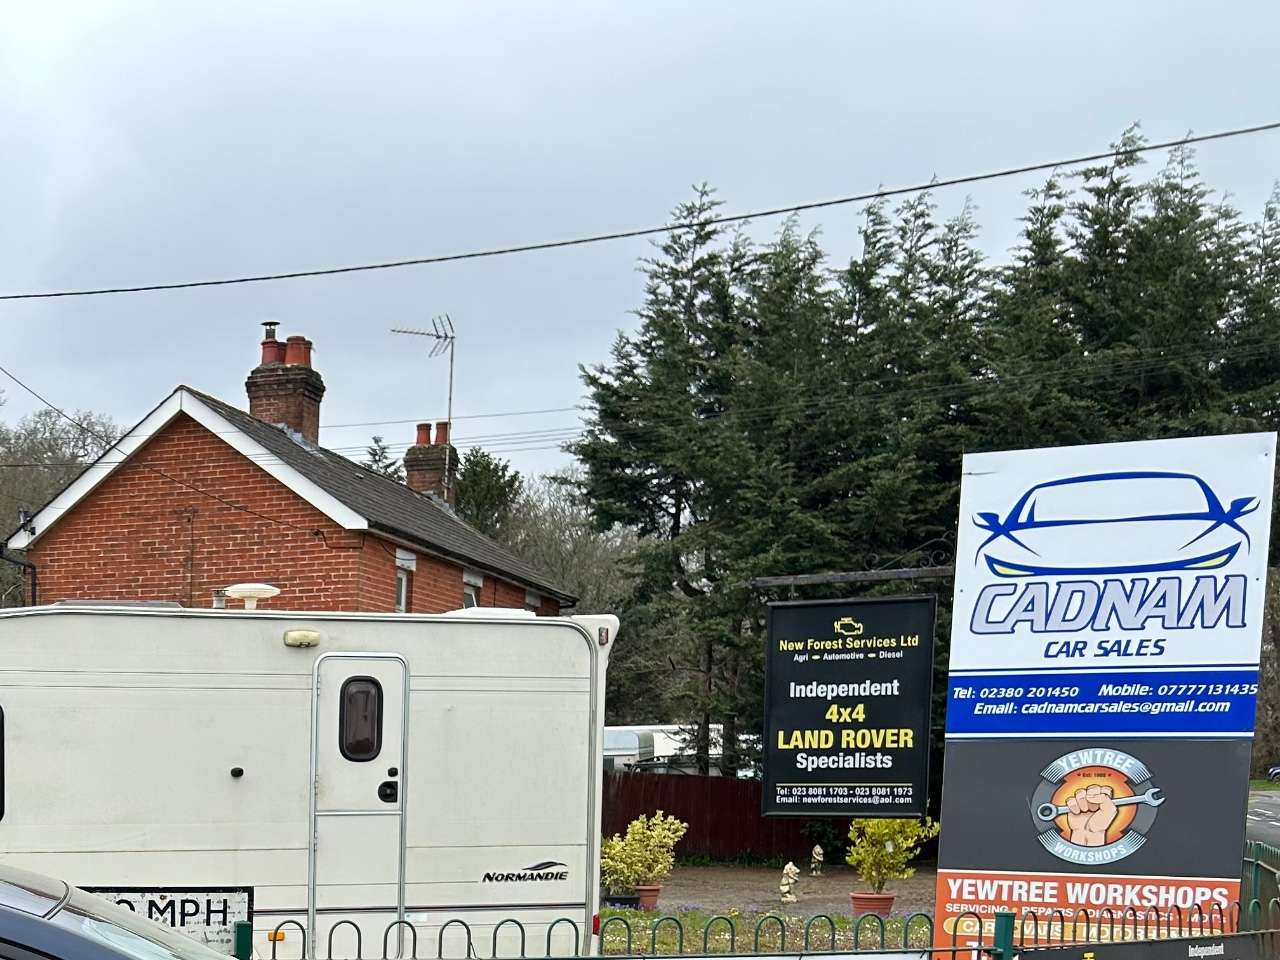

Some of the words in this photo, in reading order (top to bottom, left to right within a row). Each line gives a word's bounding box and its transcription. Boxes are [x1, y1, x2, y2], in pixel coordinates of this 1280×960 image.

[970, 575, 1248, 635] CADNAM
[779, 639, 804, 651] New
[807, 638, 842, 650] Forest
[846, 636, 896, 649] Services
[900, 635, 919, 647] Ltd
[1043, 640, 1088, 658] CAR
[1094, 638, 1167, 657] SALES
[793, 653, 809, 663] Agri
[823, 651, 864, 661] Automotive
[879, 650, 903, 659] Diesel
[789, 679, 900, 700] Independent
[953, 687, 976, 699] Tel:
[979, 687, 1023, 698] 02380
[1027, 686, 1079, 698] 201450
[1098, 683, 1153, 697] Mobile:
[1158, 684, 1259, 696] 07777131435
[825, 703, 866, 723] 4x4
[974, 702, 1018, 715] Email:
[1021, 700, 1231, 715] cadnamcarsales@gmail.com
[777, 730, 834, 750] LAND
[841, 728, 914, 749] ROVER
[795, 752, 893, 772] Specialists
[1058, 750, 1136, 772] YEWTREE
[775, 787, 791, 795] Tel:
[792, 787, 806, 795] 023
[808, 787, 827, 795] 8081
[829, 787, 848, 795] 1703
[855, 787, 870, 795] 023
[872, 787, 890, 795] 8081
[893, 787, 913, 795] 1973
[775, 795, 800, 804] Email:
[1054, 842, 1127, 862] WORKSHOPS
[947, 878, 1059, 903] YEWTREE
[1066, 882, 1229, 910] WORKSHOPS
[147, 898, 228, 928] MPH
[945, 903, 1009, 914] SERVICING
[963, 920, 995, 933] CAR
[1188, 943, 1225, 958] Independent
